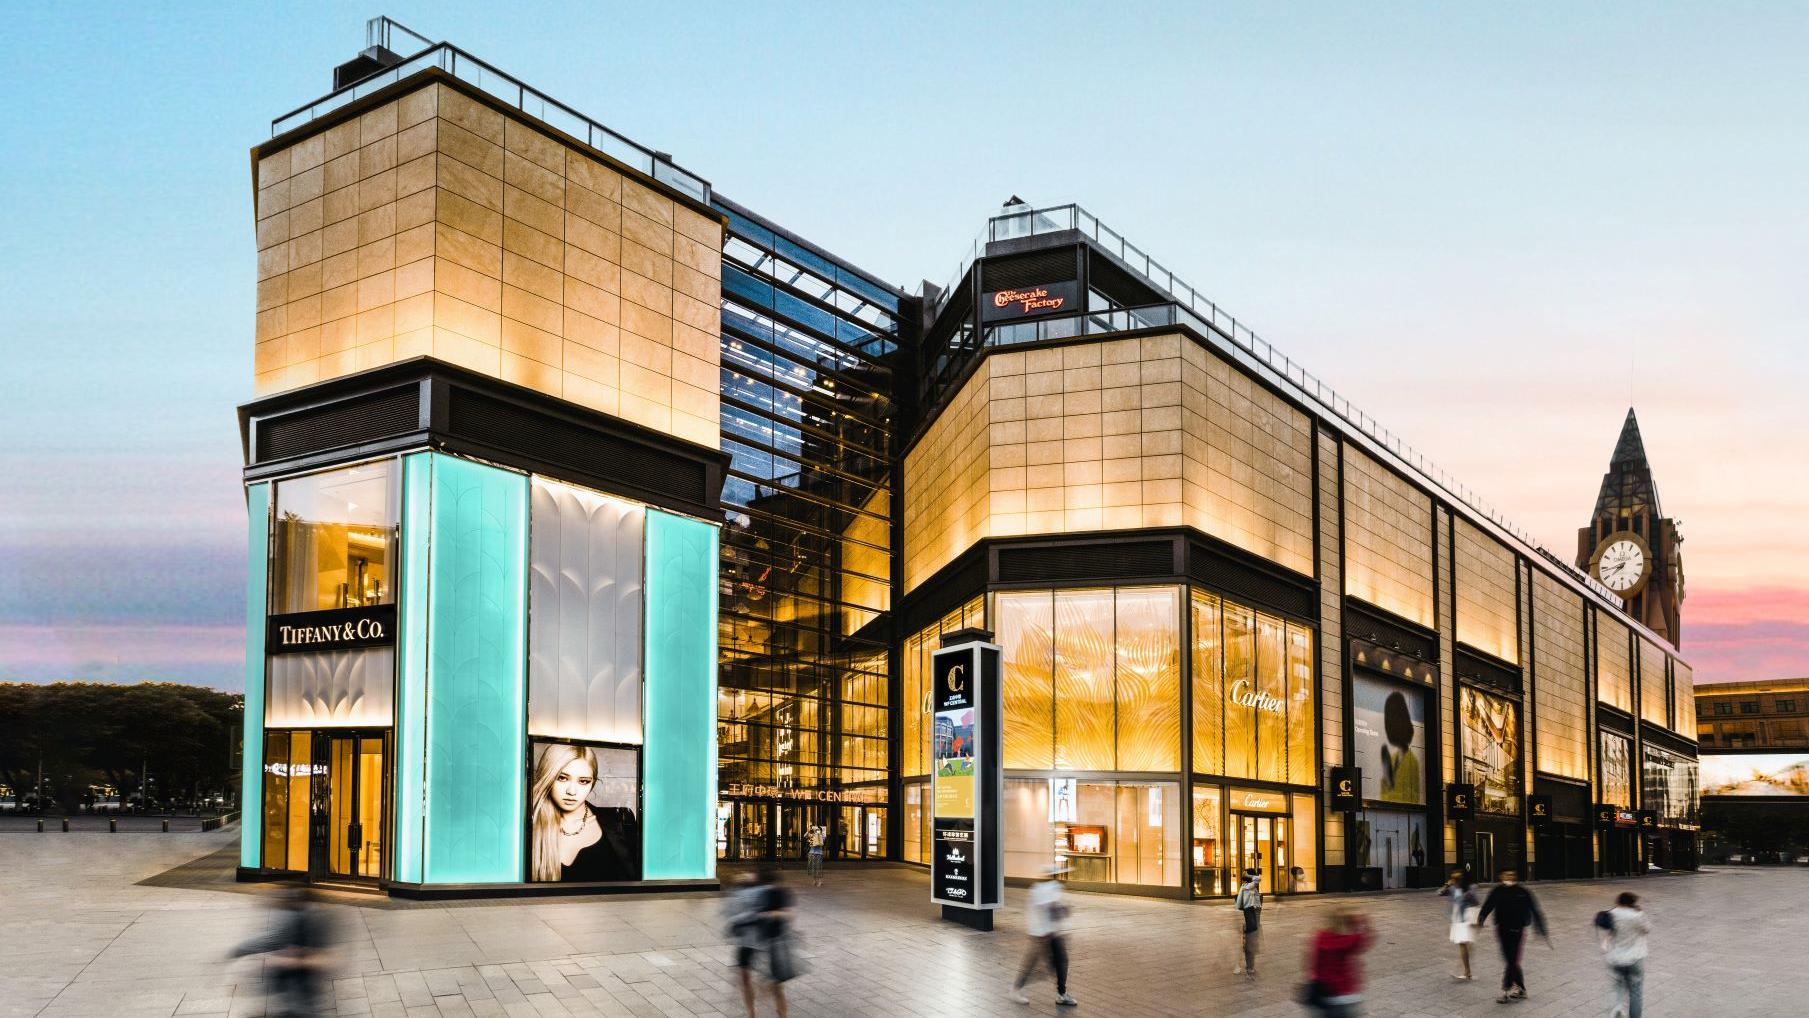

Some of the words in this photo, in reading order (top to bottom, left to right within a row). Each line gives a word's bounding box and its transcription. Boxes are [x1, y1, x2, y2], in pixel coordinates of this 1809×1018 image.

[994, 287, 1048, 307] Cheesecake
[1021, 297, 1064, 313] Factory
[1229, 678, 1285, 714] Cartier
[1243, 792, 1270, 809] Cartier
